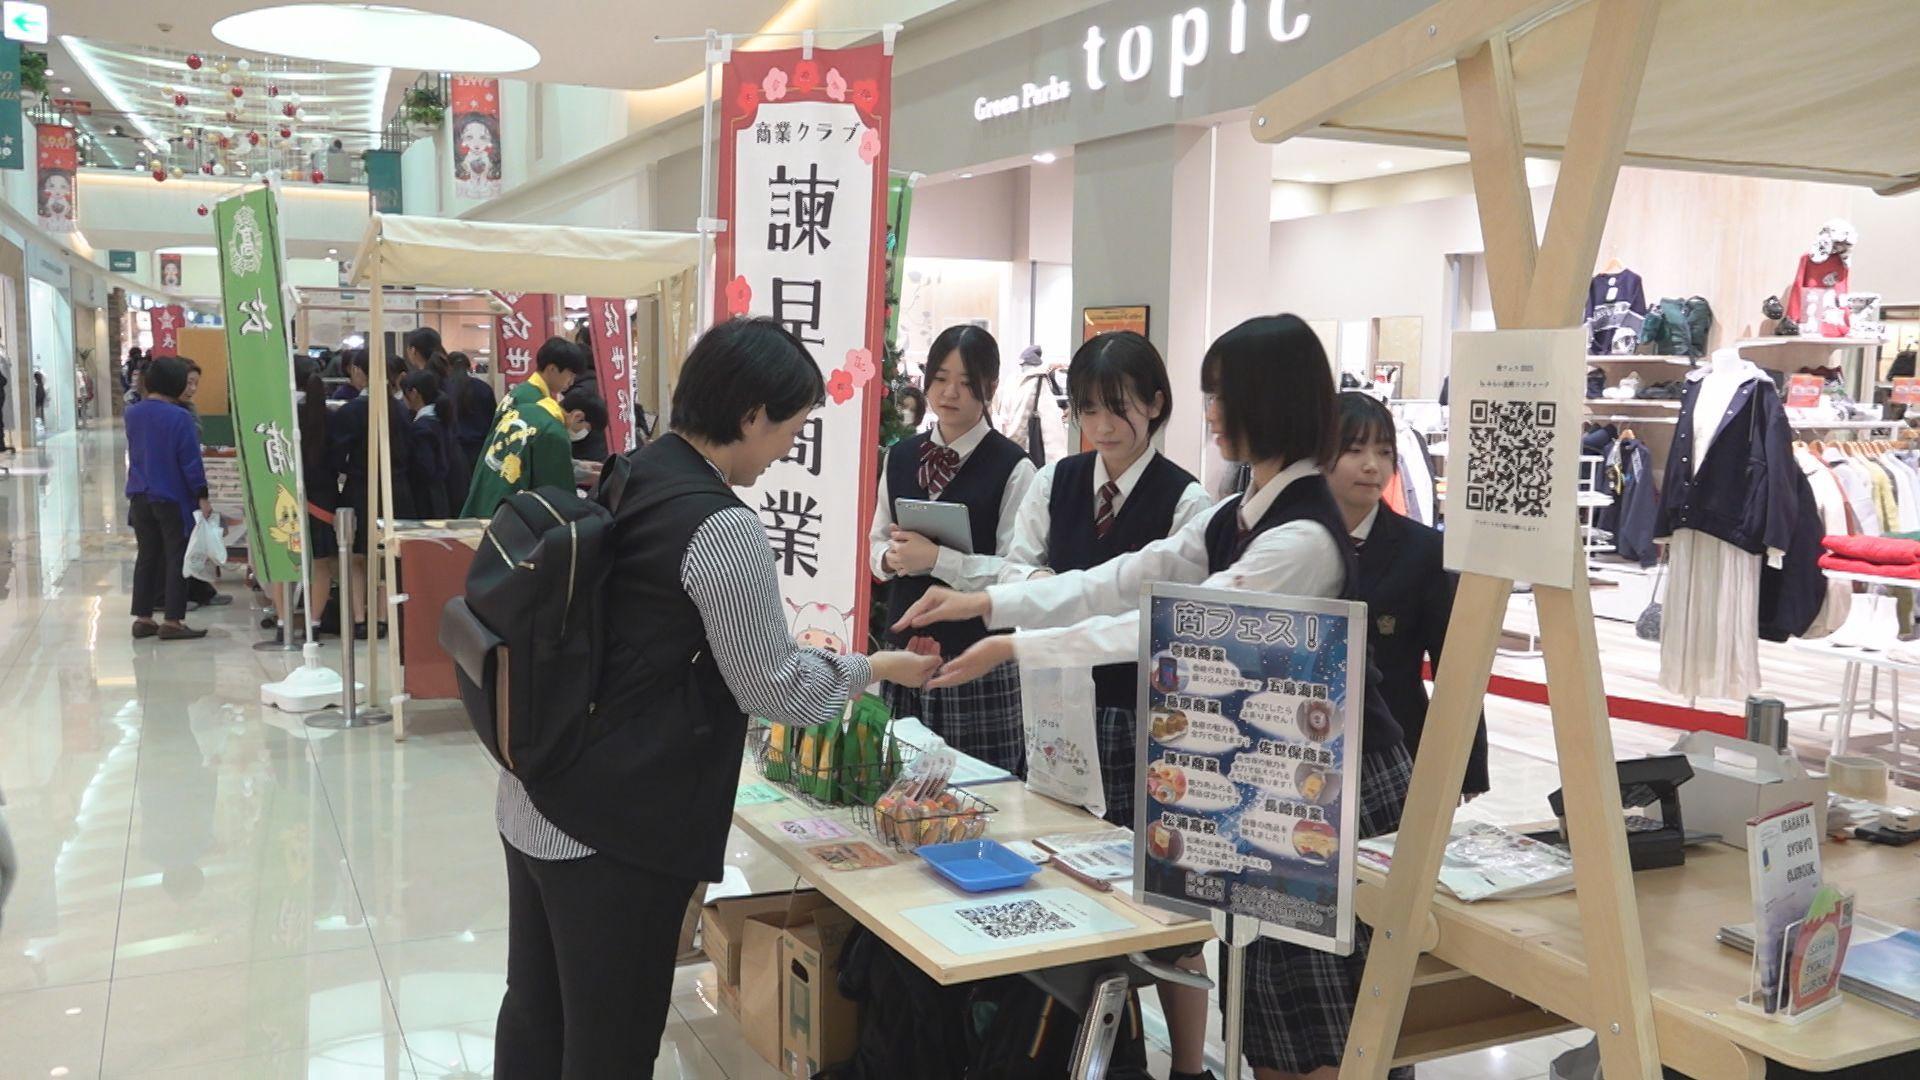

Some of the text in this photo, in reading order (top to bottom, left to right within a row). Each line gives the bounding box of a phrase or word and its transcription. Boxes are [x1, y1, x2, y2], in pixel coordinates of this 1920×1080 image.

[974, 76, 1071, 121] Green Parks
[756, 121, 861, 144] 商業クラブ
[1174, 602, 1318, 652] 商フェス！
[1259, 740, 1332, 765] 佐世保商業
[1265, 799, 1323, 822] 長崎商業
[1162, 813, 1217, 836] 松浦高校
